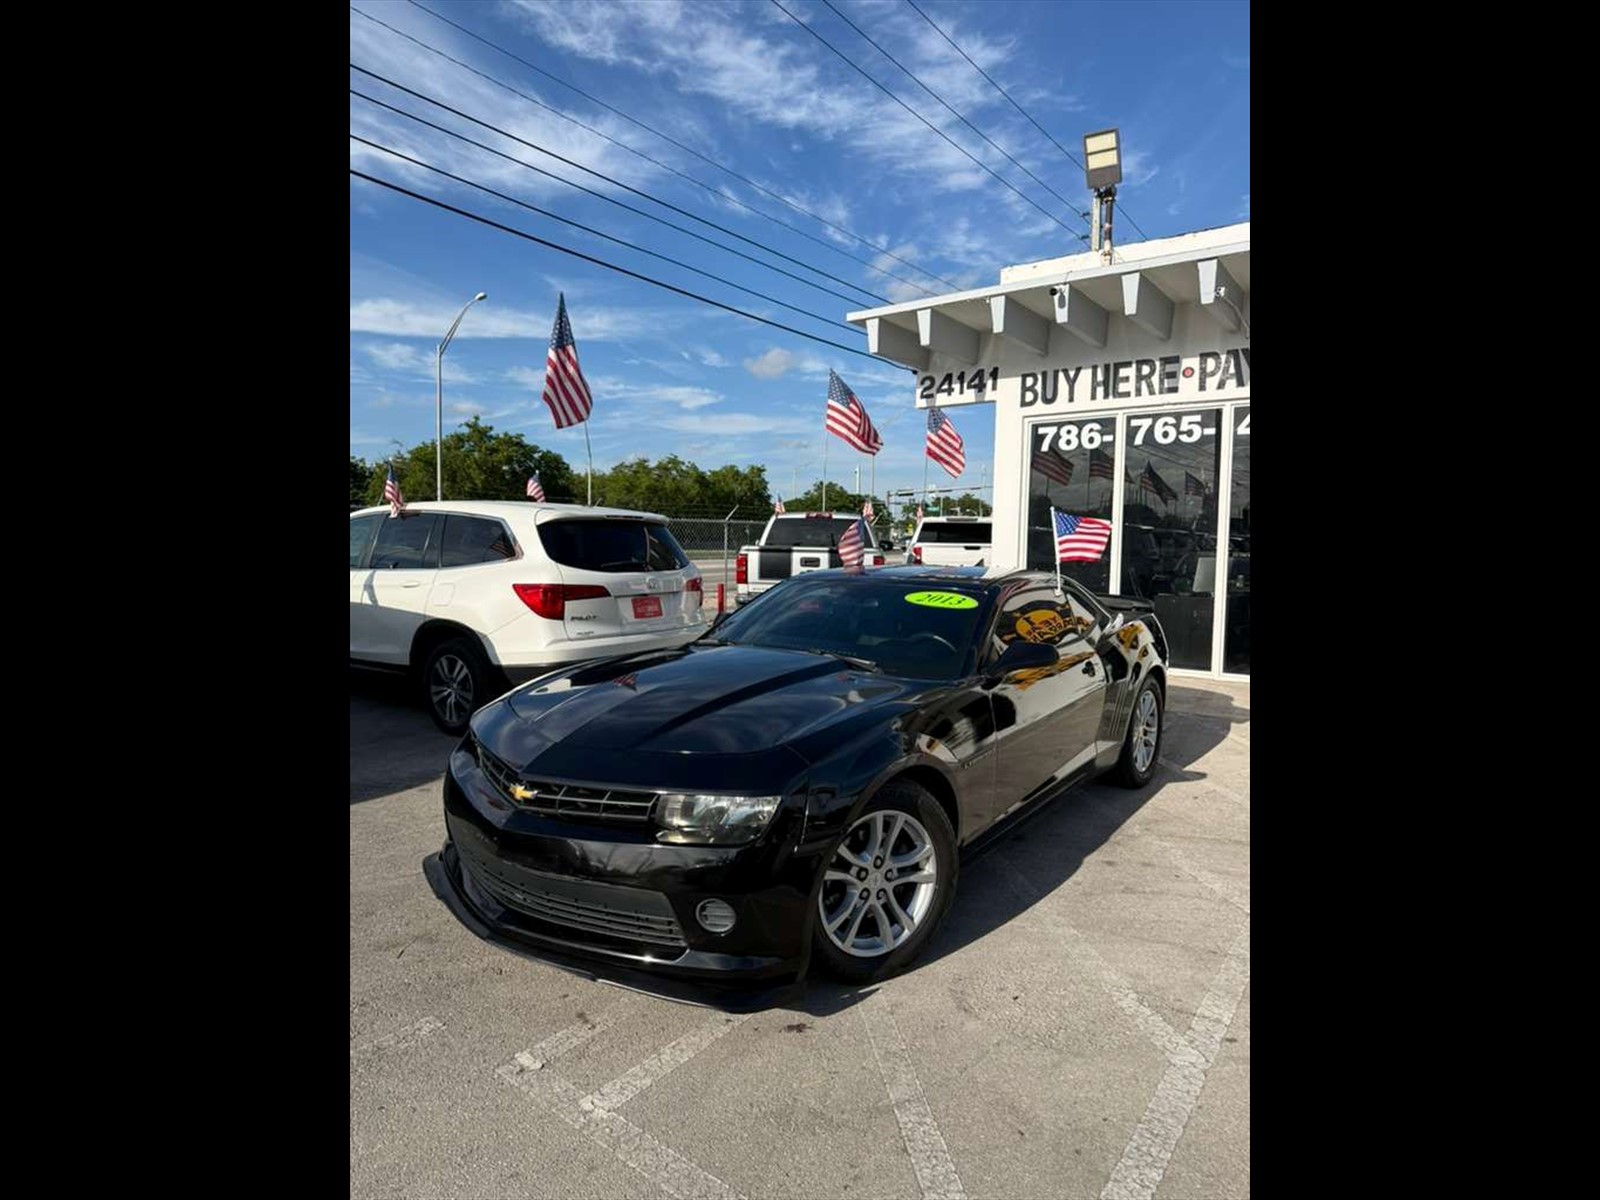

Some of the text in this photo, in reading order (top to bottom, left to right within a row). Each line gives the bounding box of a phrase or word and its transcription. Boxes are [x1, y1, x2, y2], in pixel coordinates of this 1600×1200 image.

[920, 366, 999, 399] 24141
[1020, 365, 1083, 408] BUY
[1090, 355, 1180, 400] HERE
[1037, 422, 1114, 453] 786-
[1130, 414, 1216, 445] 765-
[915, 593, 967, 606] 2013
